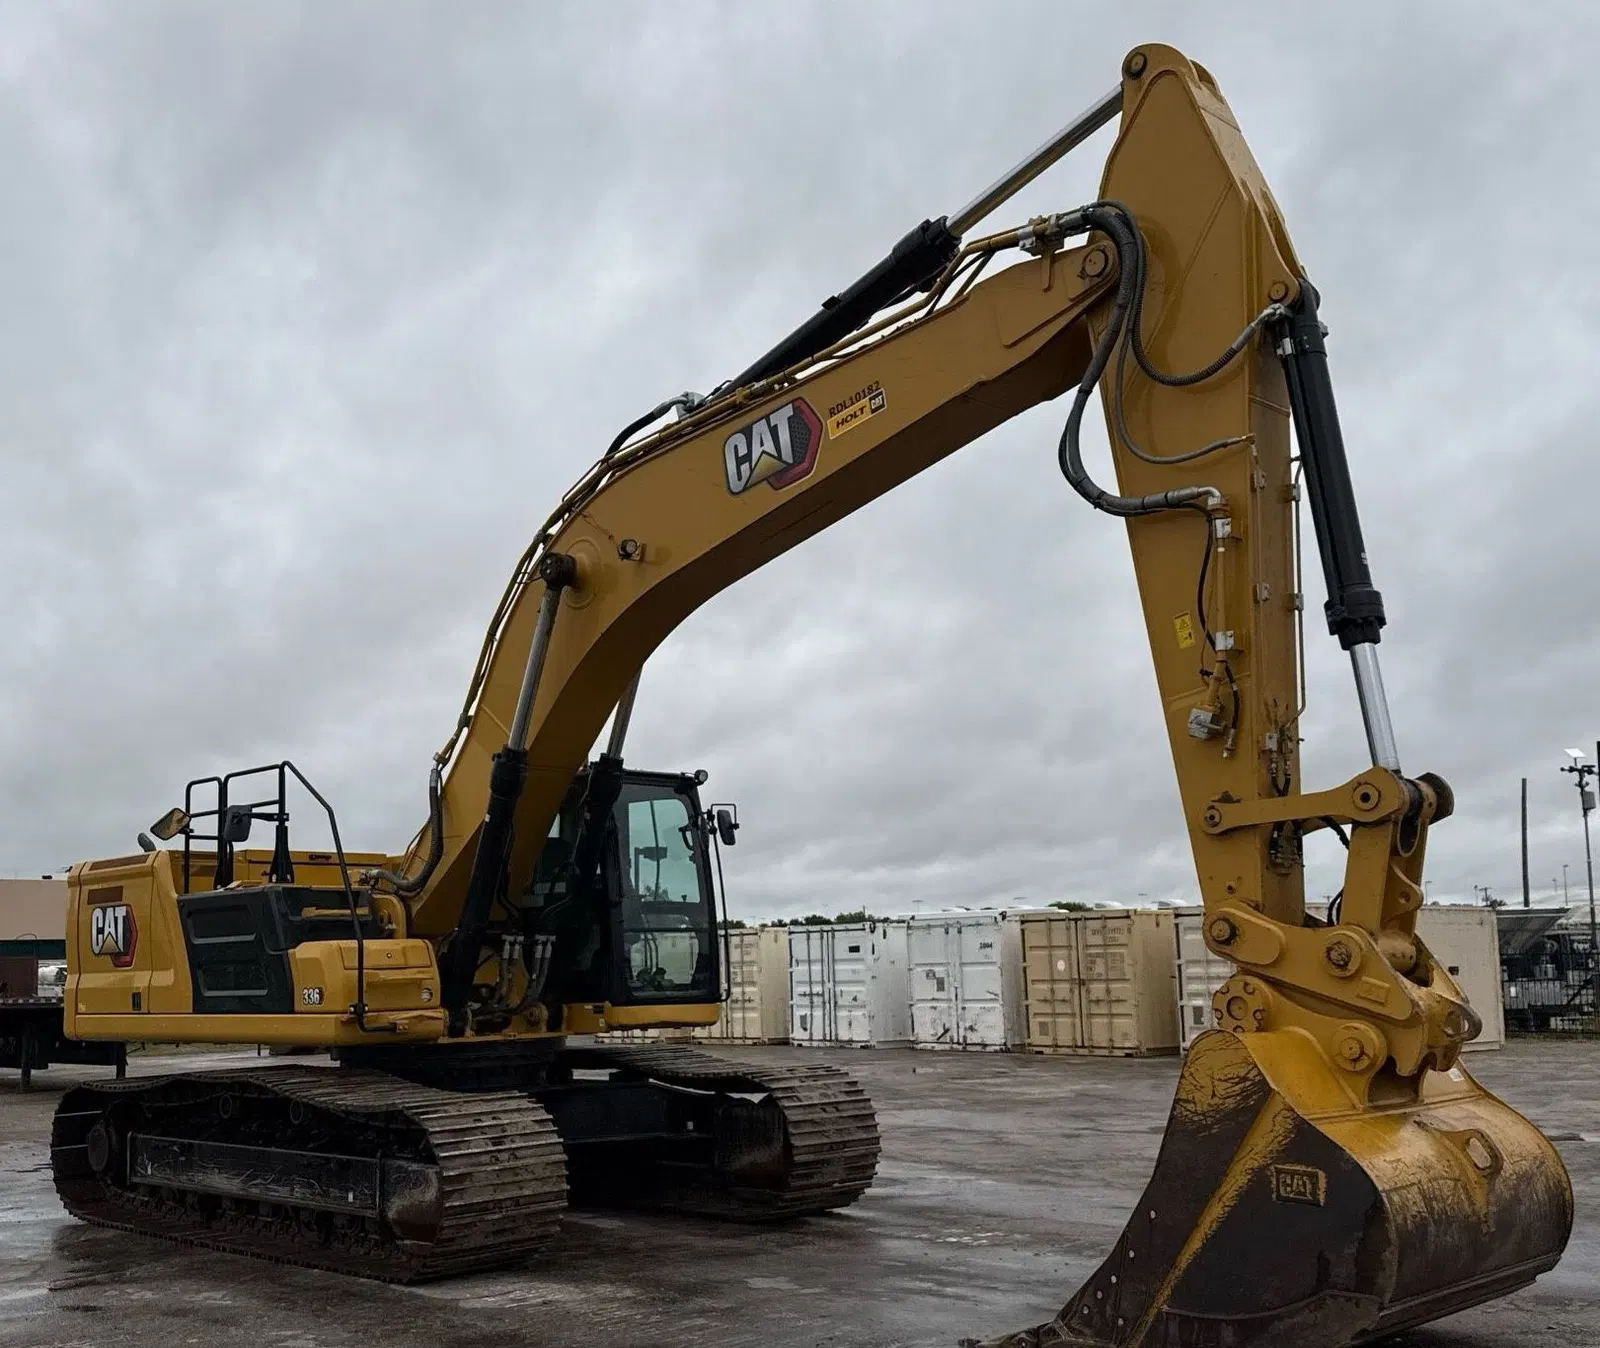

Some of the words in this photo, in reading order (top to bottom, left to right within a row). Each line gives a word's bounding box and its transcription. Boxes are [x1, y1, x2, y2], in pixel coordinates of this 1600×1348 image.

[829, 380, 881, 418] RDL10182
[836, 405, 867, 429] HOLT
[870, 395, 884, 410] CAT
[725, 403, 794, 494] CAT
[92, 906, 127, 954] CAT
[303, 988, 320, 1004] 336
[1280, 1173, 1313, 1200] CAT
